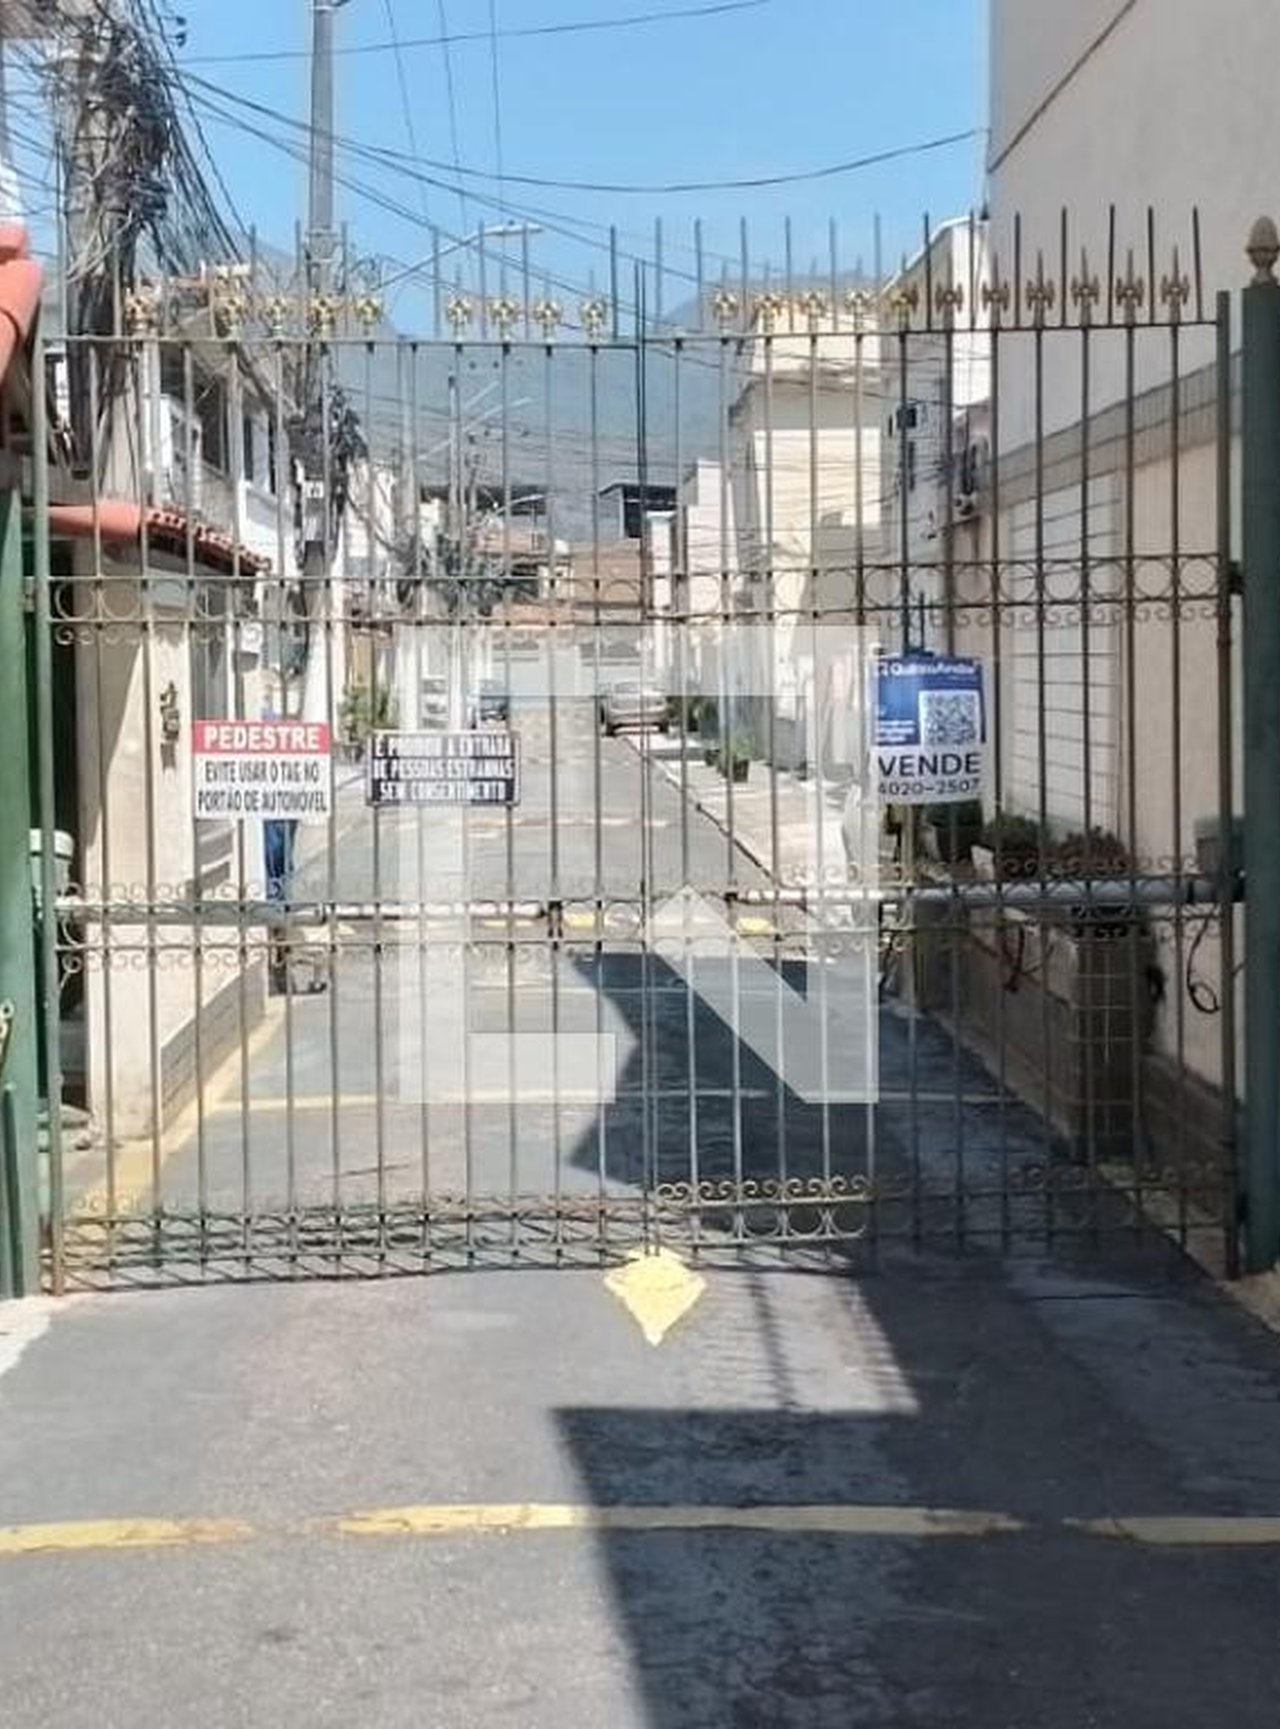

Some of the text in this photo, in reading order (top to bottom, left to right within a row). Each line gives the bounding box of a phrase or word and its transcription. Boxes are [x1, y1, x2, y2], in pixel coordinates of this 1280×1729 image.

[204, 725, 319, 750] PEDESTRE
[205, 761, 235, 782] EVITE
[239, 761, 267, 782] USAR
[270, 761, 278, 782] O
[304, 761, 319, 782] NO
[878, 753, 981, 776] VENDE
[878, 779, 980, 795] 4020-2507
[244, 790, 259, 811] DE
